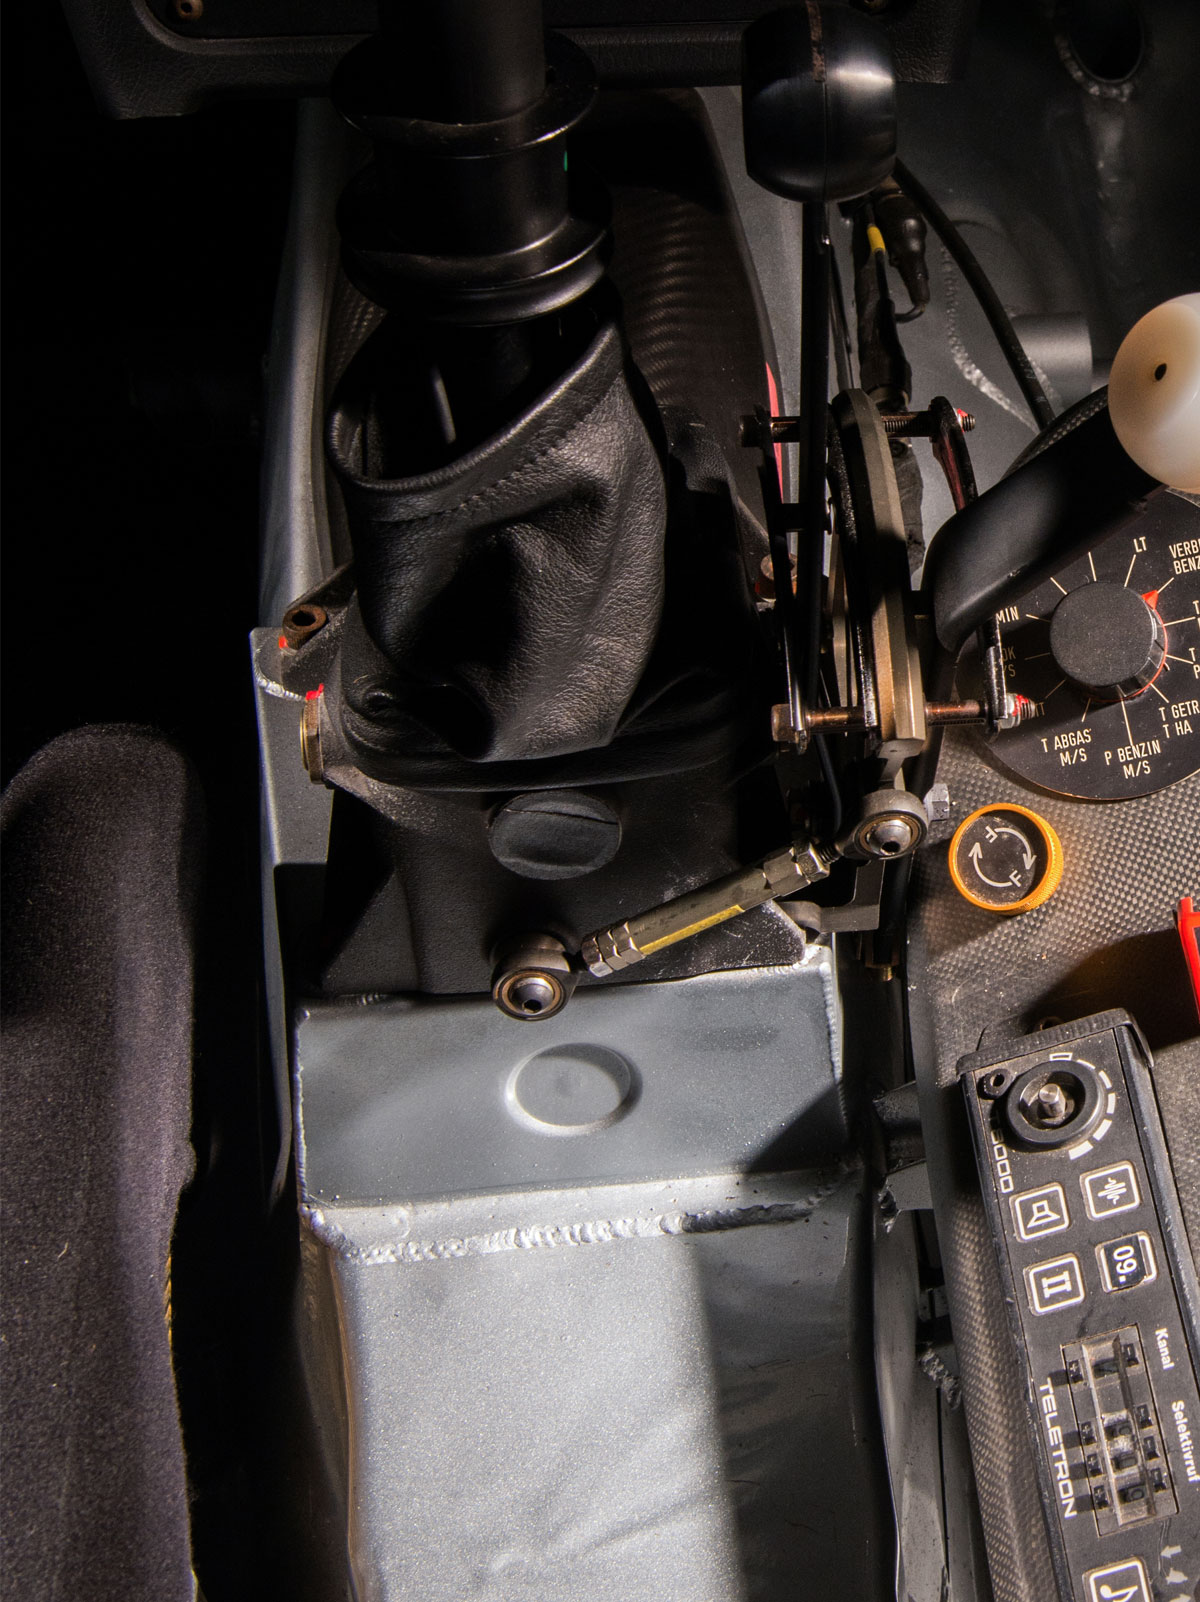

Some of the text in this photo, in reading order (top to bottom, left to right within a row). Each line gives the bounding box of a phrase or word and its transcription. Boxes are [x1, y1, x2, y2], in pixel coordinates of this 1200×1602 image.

[1133, 536, 1147, 553] LT
[1192, 600, 1200, 615] T
[1188, 647, 1196, 662] T
[1193, 664, 1200, 679] P
[1158, 700, 1200, 722] T GETR
[1162, 719, 1193, 739] T HA
[1040, 728, 1092, 753] T ABGAS
[1059, 748, 1088, 767] M/S
[1104, 739, 1161, 766] P BENZIN
[1123, 760, 1151, 779] M/S
[1154, 1327, 1175, 1371] Kanal
[1039, 1377, 1078, 1520] TELETRON
[1171, 1400, 1200, 1484] Selektivruf
